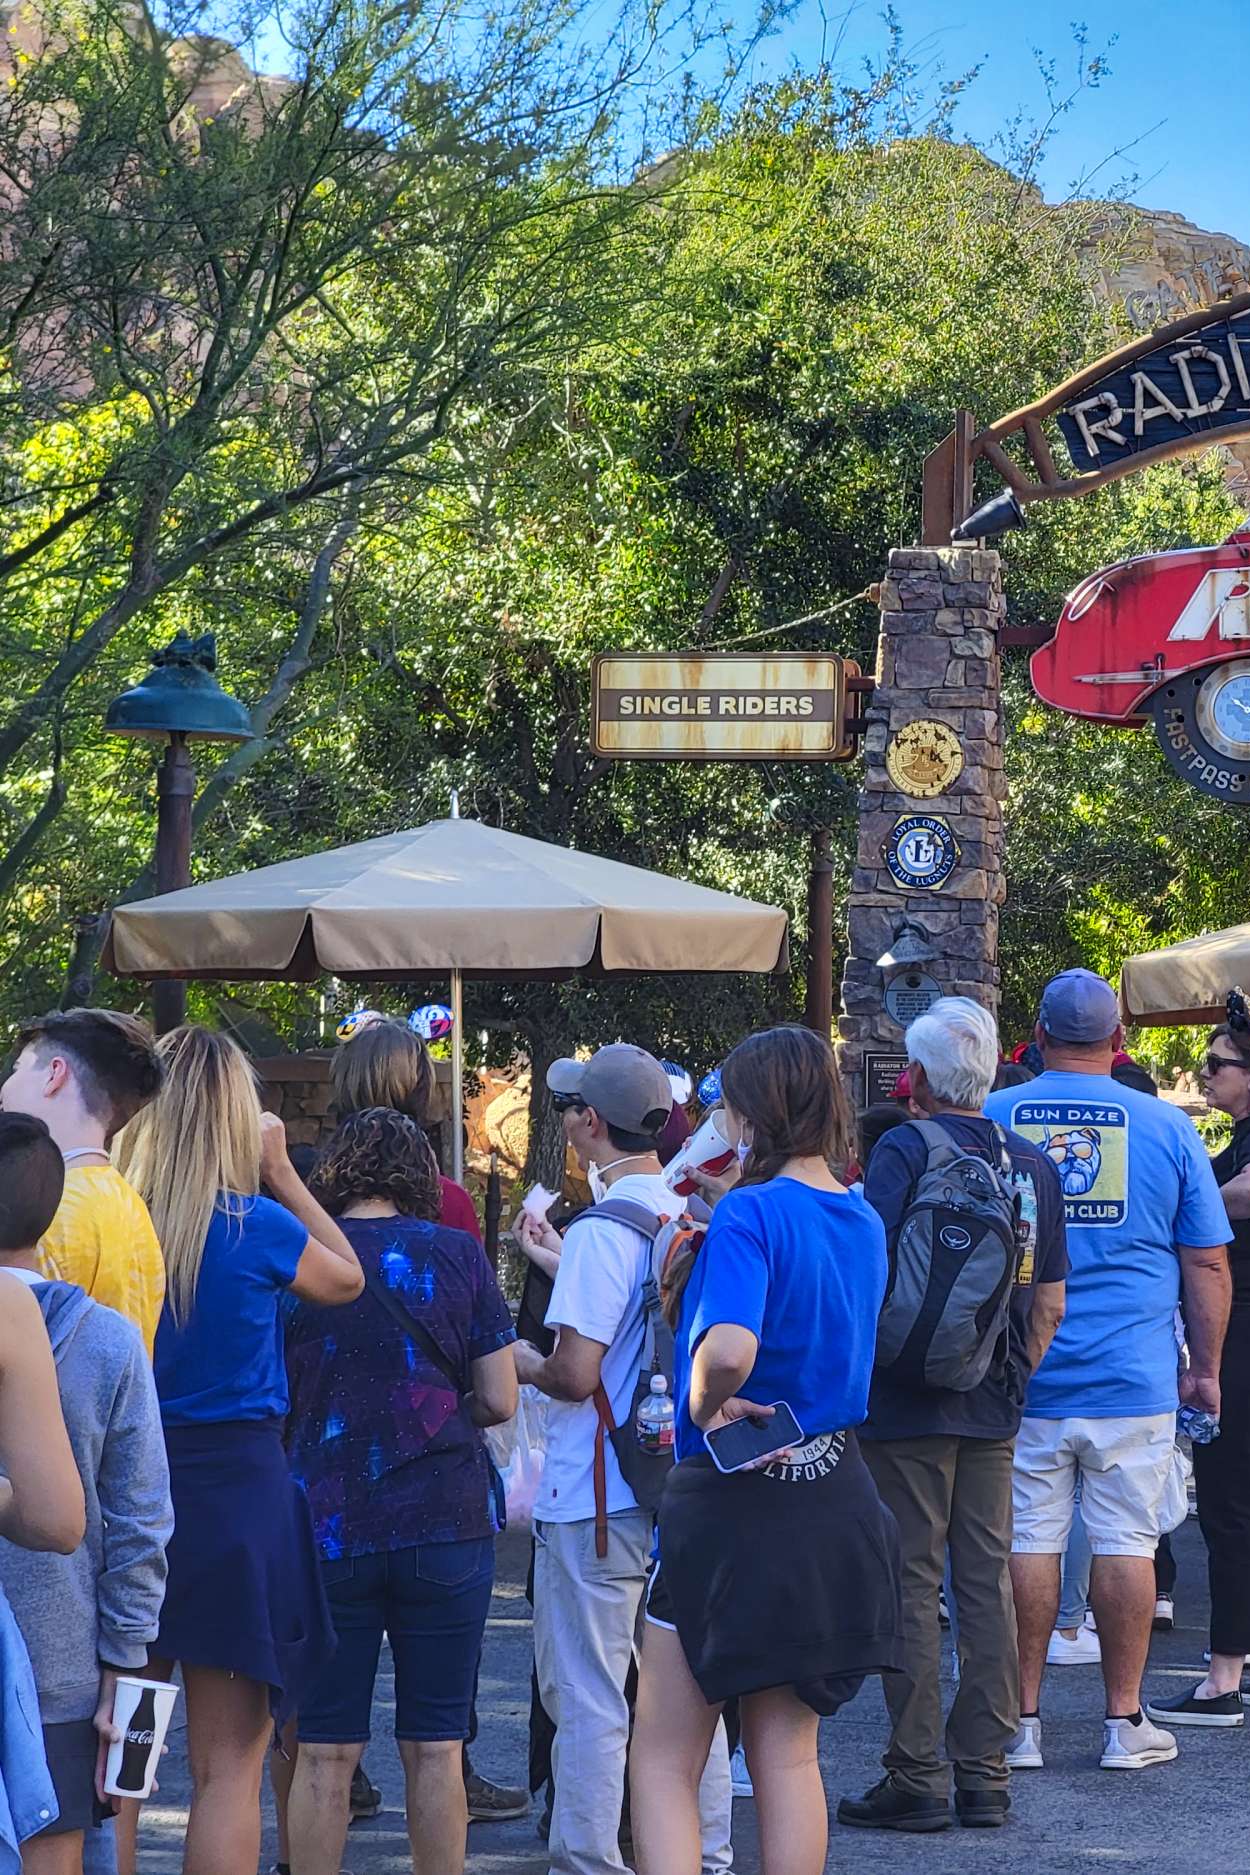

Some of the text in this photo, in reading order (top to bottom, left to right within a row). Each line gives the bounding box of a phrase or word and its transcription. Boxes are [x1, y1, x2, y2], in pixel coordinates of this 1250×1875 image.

[619, 696, 814, 715] SINGLE RIDERS
[1164, 707, 1247, 792] FASTPASS
[892, 819, 951, 844] LOYAL ORDER
[894, 865, 912, 884] THE
[916, 854, 953, 885] LUGNUTS
[1020, 1109, 1119, 1122] SUN DAZE
[1078, 1205, 1119, 1218] CLUB
[762, 1430, 847, 1482] LIFORNIA
[802, 1438, 828, 1461] 1944
